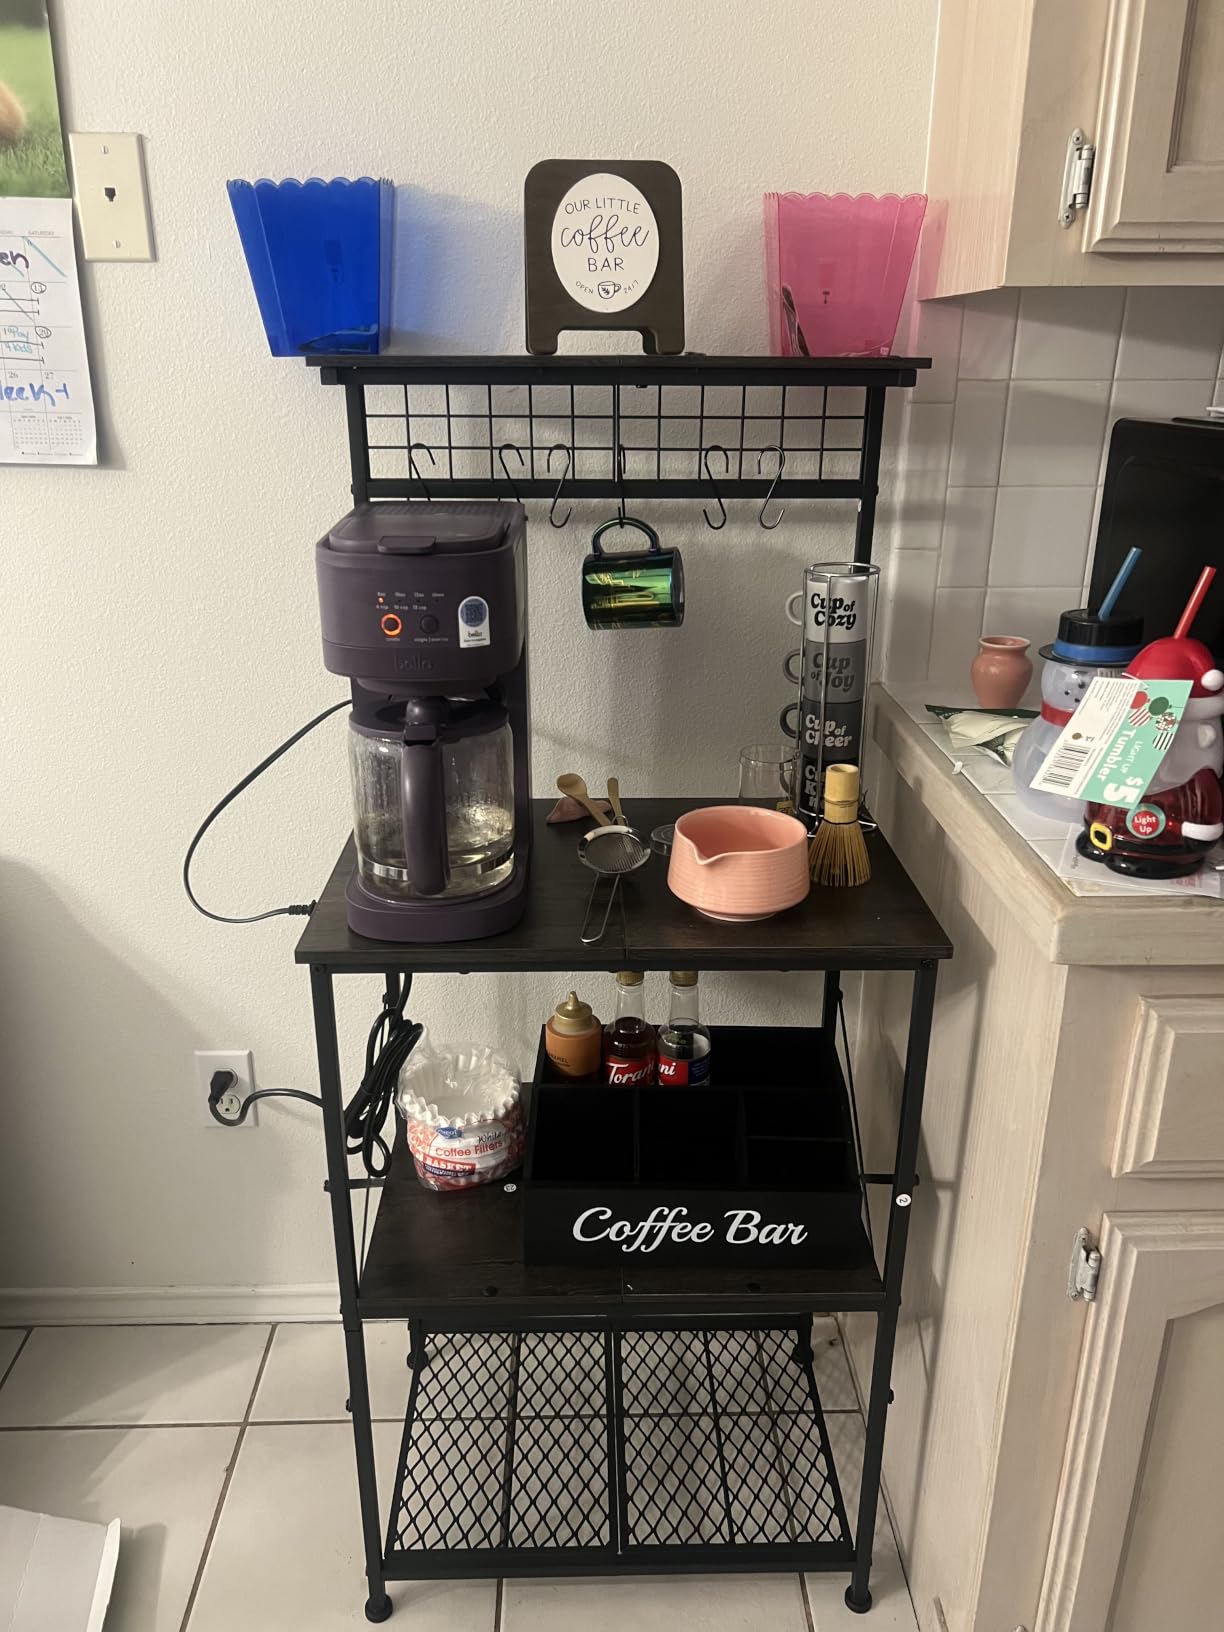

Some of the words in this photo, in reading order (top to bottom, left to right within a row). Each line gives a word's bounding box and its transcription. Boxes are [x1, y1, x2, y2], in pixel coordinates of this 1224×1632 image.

[564, 199, 591, 215] OUR
[595, 197, 641, 214] LITTLE
[560, 214, 650, 253] coffee
[587, 257, 625, 272] BAR
[575, 280, 594, 294] OPEN
[811, 593, 844, 614] Cup
[843, 600, 856, 612] of
[814, 610, 856, 630] Cozy
[813, 653, 850, 674] Cup
[805, 714, 836, 734] Cup
[834, 725, 847, 735] of
[1097, 729, 1136, 782] Tumbler
[1134, 813, 1157, 825] Light
[1139, 825, 1152, 834] Up
[435, 1147, 472, 1157] Coffee
[474, 1141, 503, 1154] Filters
[572, 1206, 715, 1253] Coffee
[723, 1209, 808, 1245] Bar
